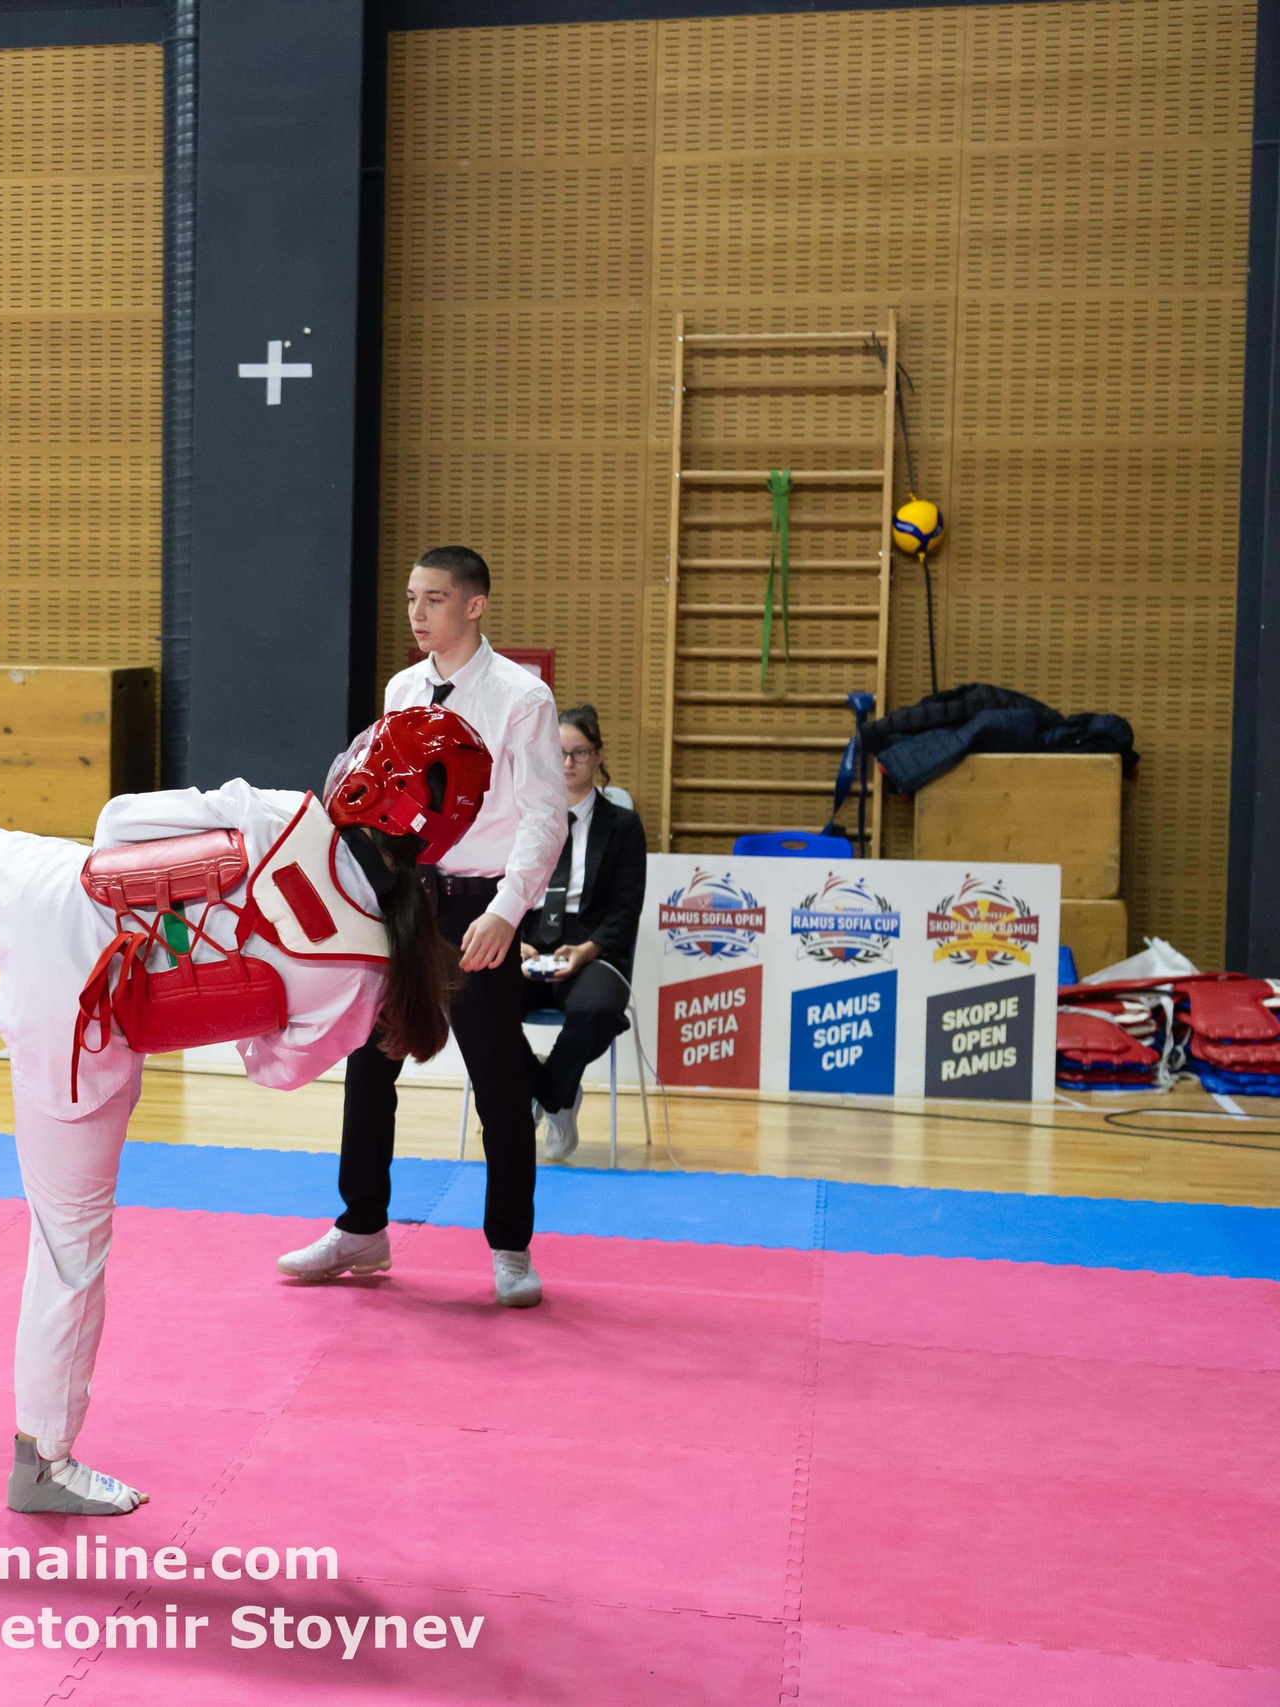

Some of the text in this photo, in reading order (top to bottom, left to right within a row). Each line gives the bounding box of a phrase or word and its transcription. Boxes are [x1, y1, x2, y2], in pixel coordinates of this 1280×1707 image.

[662, 911, 763, 926] RAMUS SOFIA OPEN
[793, 915, 898, 932] RAMUS SOFIA CUP
[929, 920, 1037, 935] SKOPJE OPEN RAMUS
[674, 987, 746, 1020] RAMUS
[807, 991, 881, 1027] RAMUS
[941, 996, 1019, 1032] SKOPJE
[680, 1013, 739, 1044] SOFIA
[813, 1018, 873, 1050] SOFIA
[951, 1023, 1006, 1055] OPEN
[682, 1038, 735, 1067] OPEN
[822, 1045, 863, 1071] CUP
[940, 1046, 1017, 1081] RAMUS
